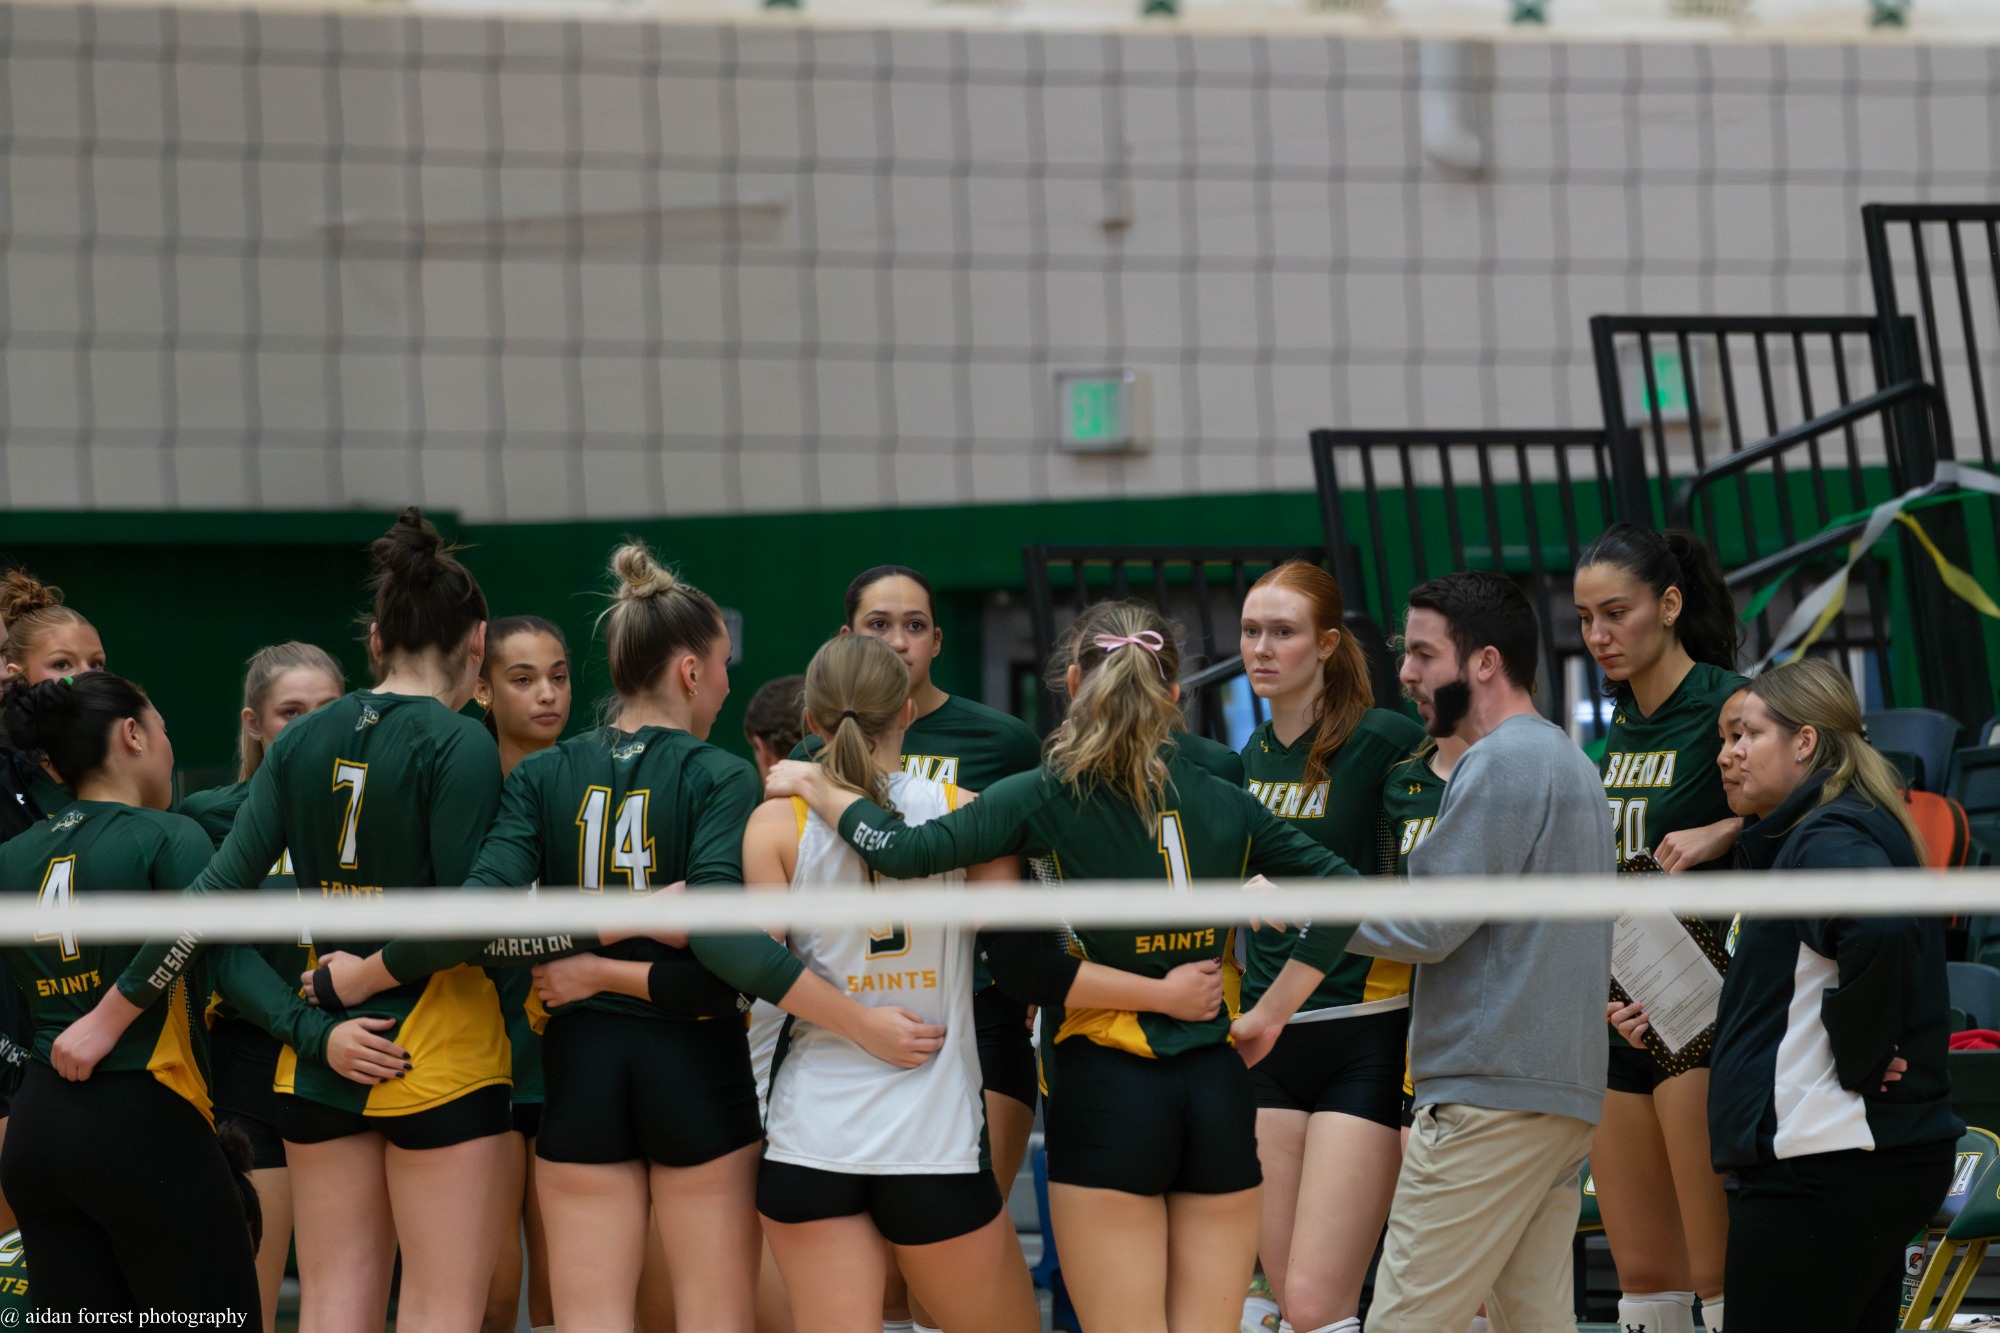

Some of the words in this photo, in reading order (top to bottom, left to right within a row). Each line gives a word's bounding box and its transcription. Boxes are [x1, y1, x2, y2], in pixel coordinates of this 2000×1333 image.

[1603, 751, 1677, 788] SIENA
[332, 758, 368, 869] 7
[575, 785, 657, 893] 14
[1157, 810, 1193, 893] 1
[34, 854, 81, 962] 4
[547, 934, 574, 953] ON
[1135, 928, 1215, 954] SAINTS
[36, 970, 102, 996] SAINTS
[147, 965, 174, 990] GO
[846, 970, 938, 993] SAINTS
